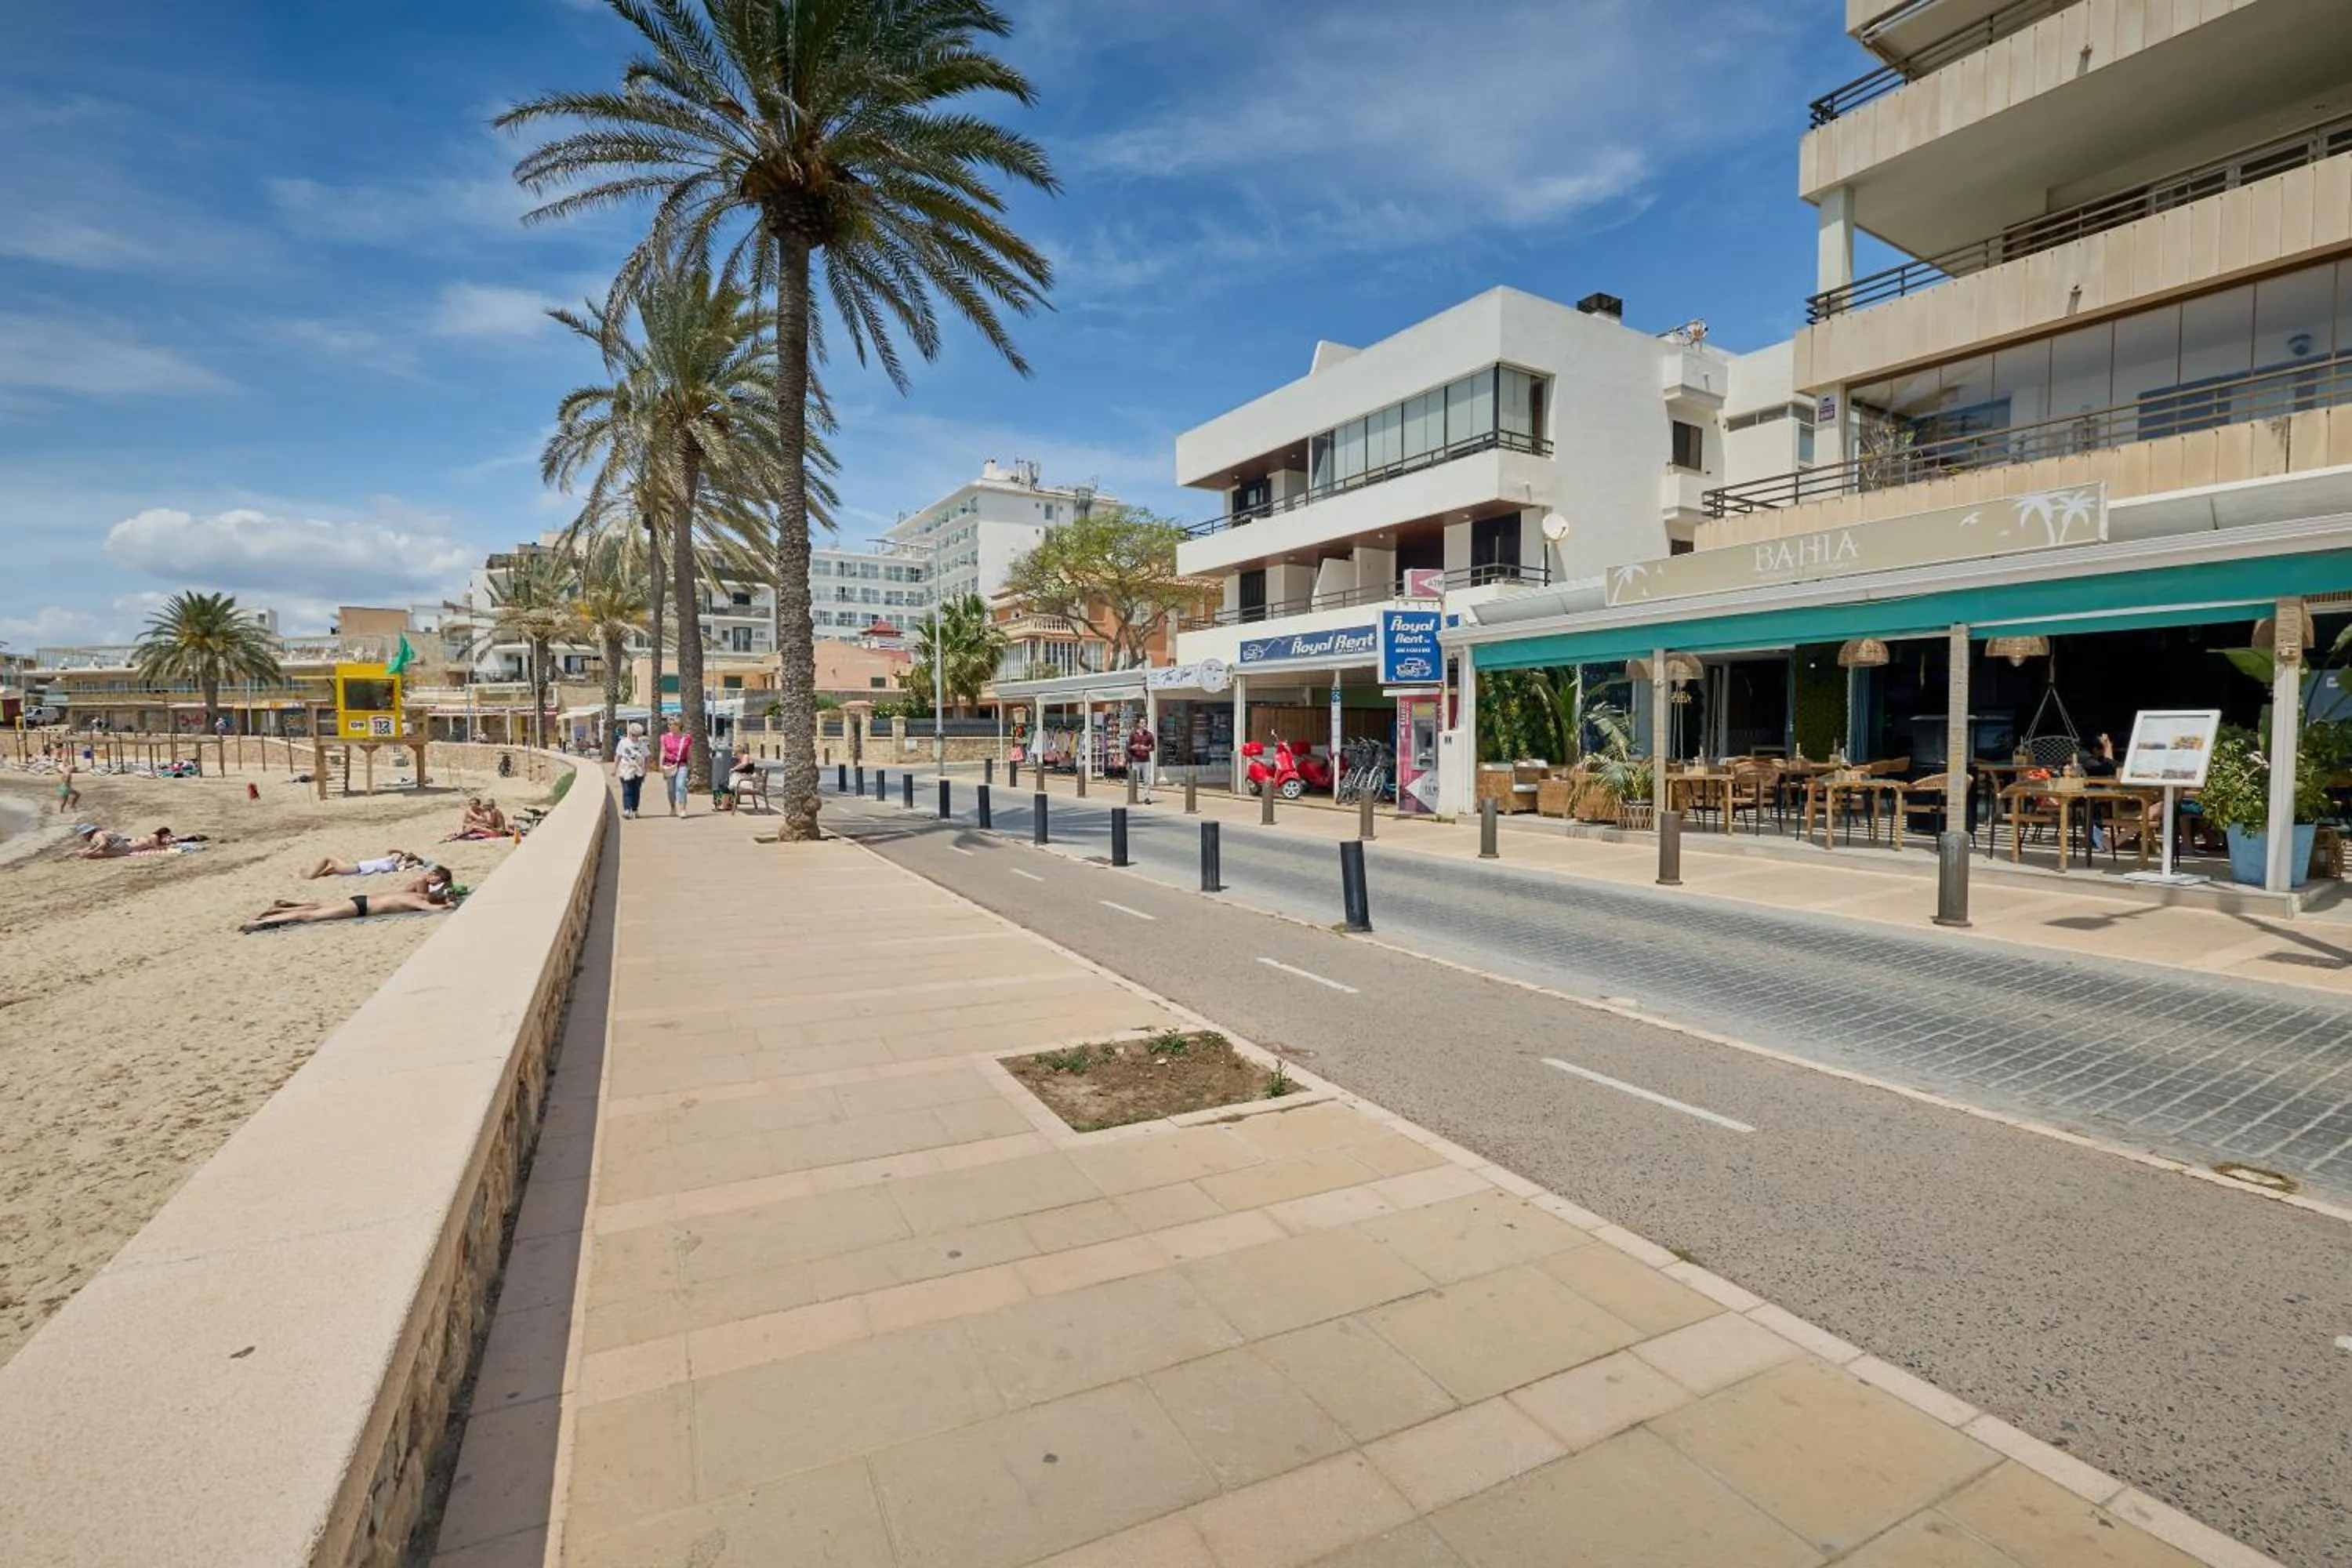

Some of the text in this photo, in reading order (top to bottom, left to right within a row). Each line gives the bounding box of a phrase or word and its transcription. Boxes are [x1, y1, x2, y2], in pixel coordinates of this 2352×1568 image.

[1754, 531, 1860, 572] BAHIA
[1390, 617, 1436, 634] Royal
[1291, 633, 1375, 655] Royal Rent
[1395, 633, 1424, 644] Rent
